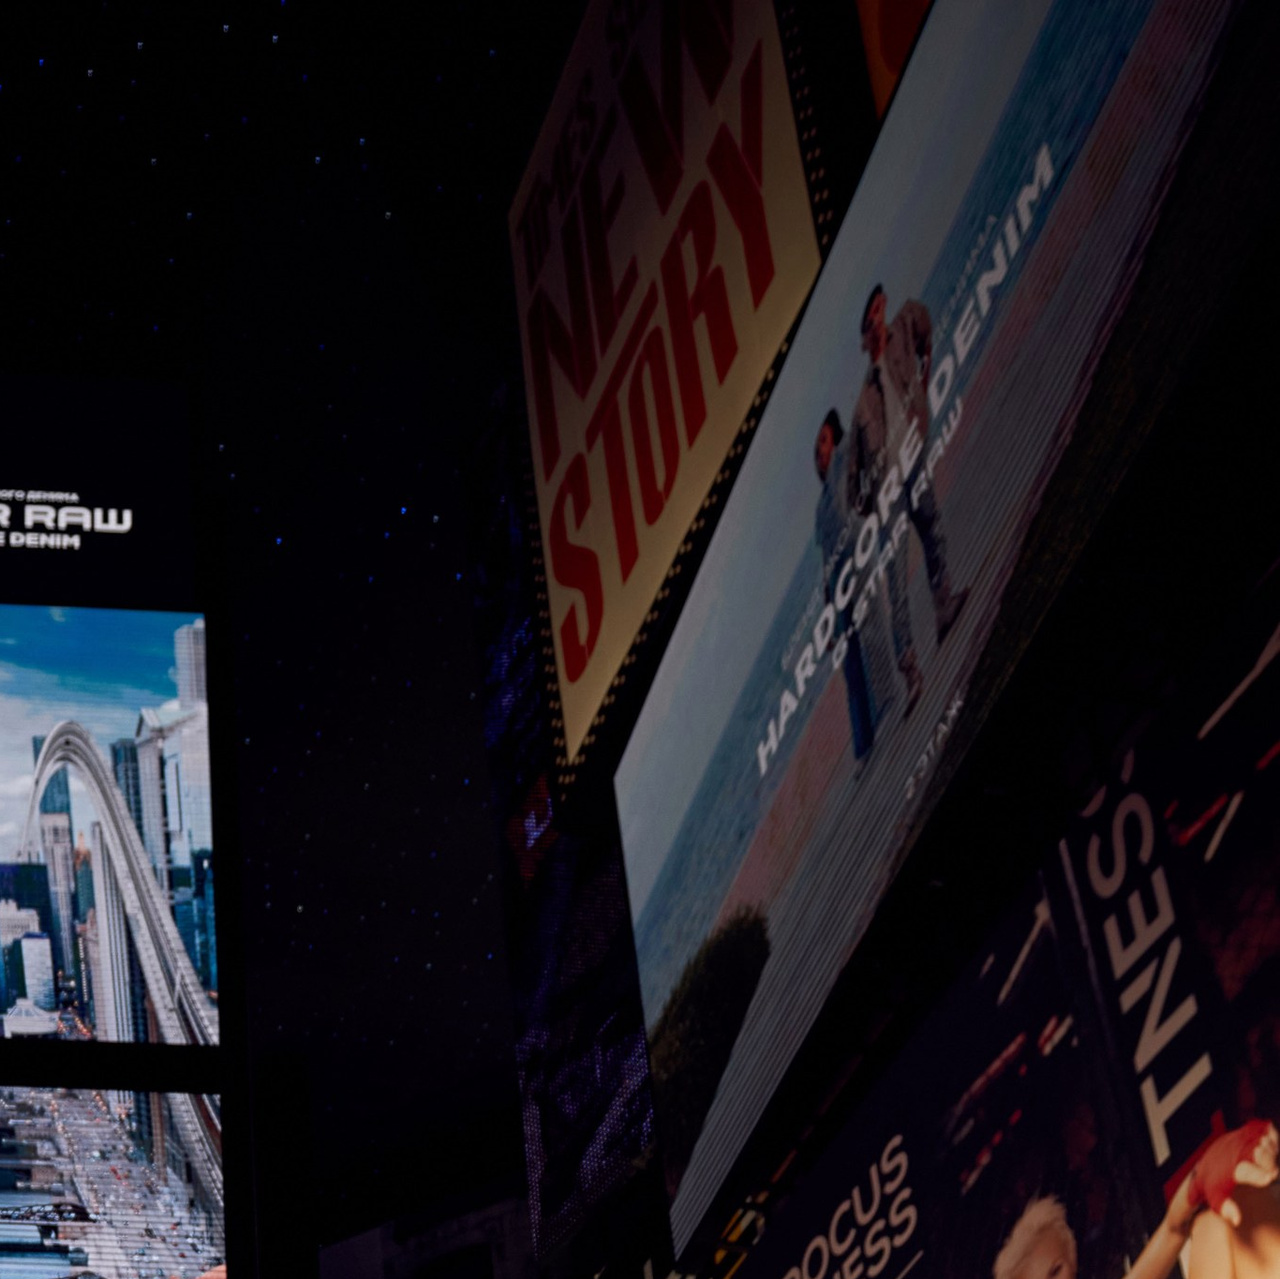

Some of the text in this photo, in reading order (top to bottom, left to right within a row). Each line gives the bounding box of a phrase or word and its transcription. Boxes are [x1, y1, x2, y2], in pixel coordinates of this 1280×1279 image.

[24, 504, 133, 534] RAW
[549, 37, 775, 684] STORY
[757, 143, 1057, 777] HARDCORE DENIM
[9, 531, 81, 550] DENIM
